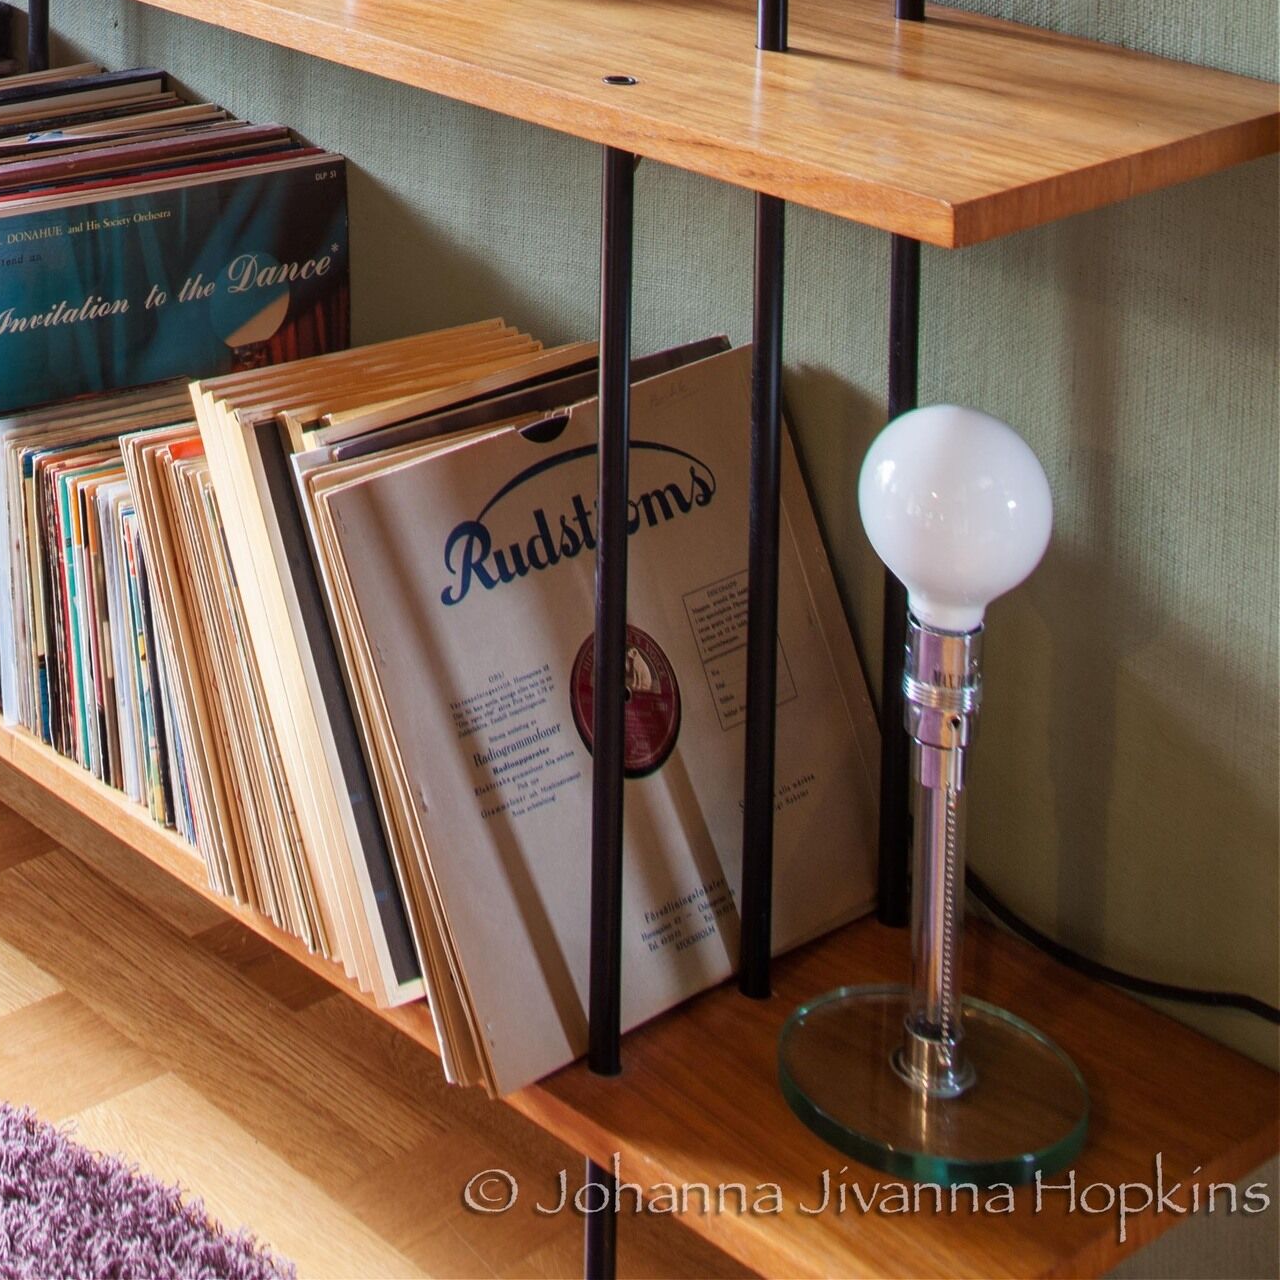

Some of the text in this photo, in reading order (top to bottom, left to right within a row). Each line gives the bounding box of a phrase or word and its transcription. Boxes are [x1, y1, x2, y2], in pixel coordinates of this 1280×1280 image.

[315, 171, 328, 182] DLP
[7, 225, 63, 245] DONAHUE
[68, 222, 84, 234] and
[86, 218, 101, 230] His
[103, 215, 130, 230] Society
[133, 208, 171, 224] Orchestra
[143, 284, 167, 310] to
[178, 273, 216, 304] the
[227, 253, 331, 293] Dance
[441, 450, 716, 606] Rudstms
[473, 723, 561, 768] Radiogrammofoner
[492, 747, 550, 775] Radioapparater
